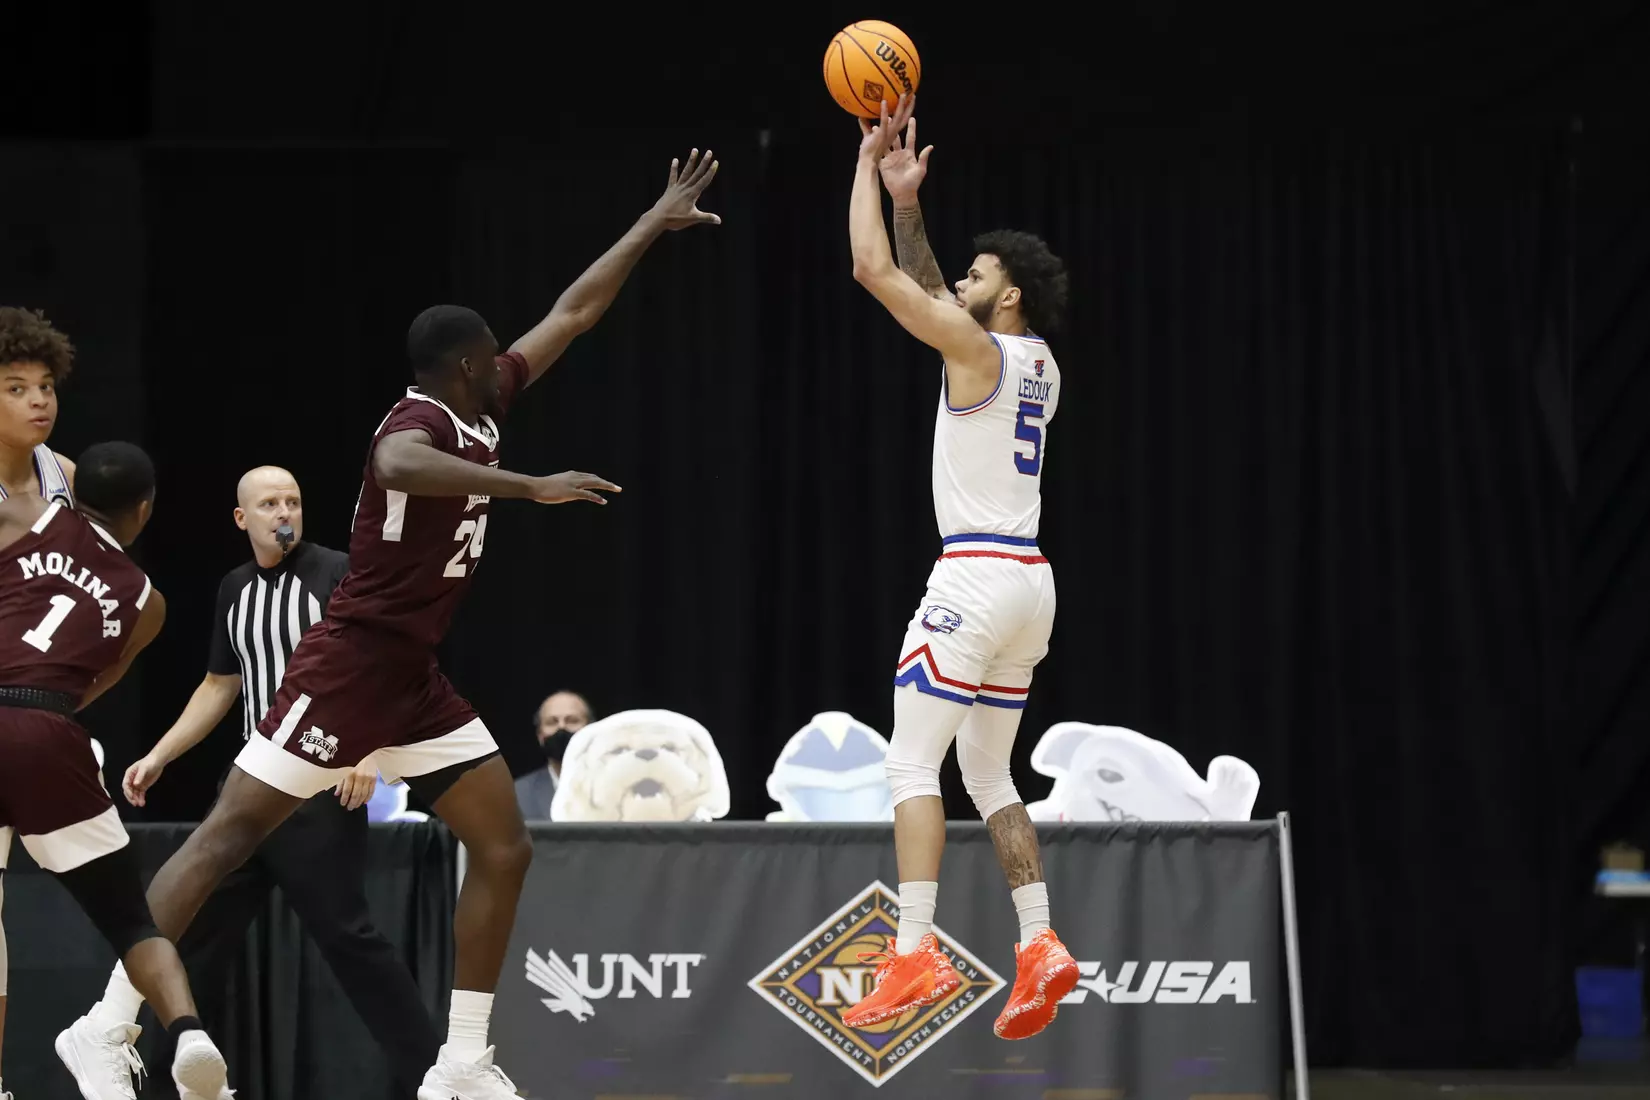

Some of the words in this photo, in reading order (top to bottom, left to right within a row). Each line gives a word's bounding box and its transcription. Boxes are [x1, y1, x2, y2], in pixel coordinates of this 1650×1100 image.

[875, 40, 913, 96] Wilson
[1018, 376, 1053, 402] LEDOUX
[1013, 400, 1044, 476] 5
[442, 514, 488, 578] 24
[17, 551, 122, 639] MOLINAR
[21, 594, 77, 653] 1
[307, 735, 334, 754] STATE
[778, 903, 872, 979] NATIONAL
[882, 901, 978, 979] INTION
[572, 953, 702, 999] UNT
[778, 989, 873, 1066] TOURNAMENT
[886, 1025, 932, 1064] NORTH
[931, 990, 975, 1031] TEXAS
